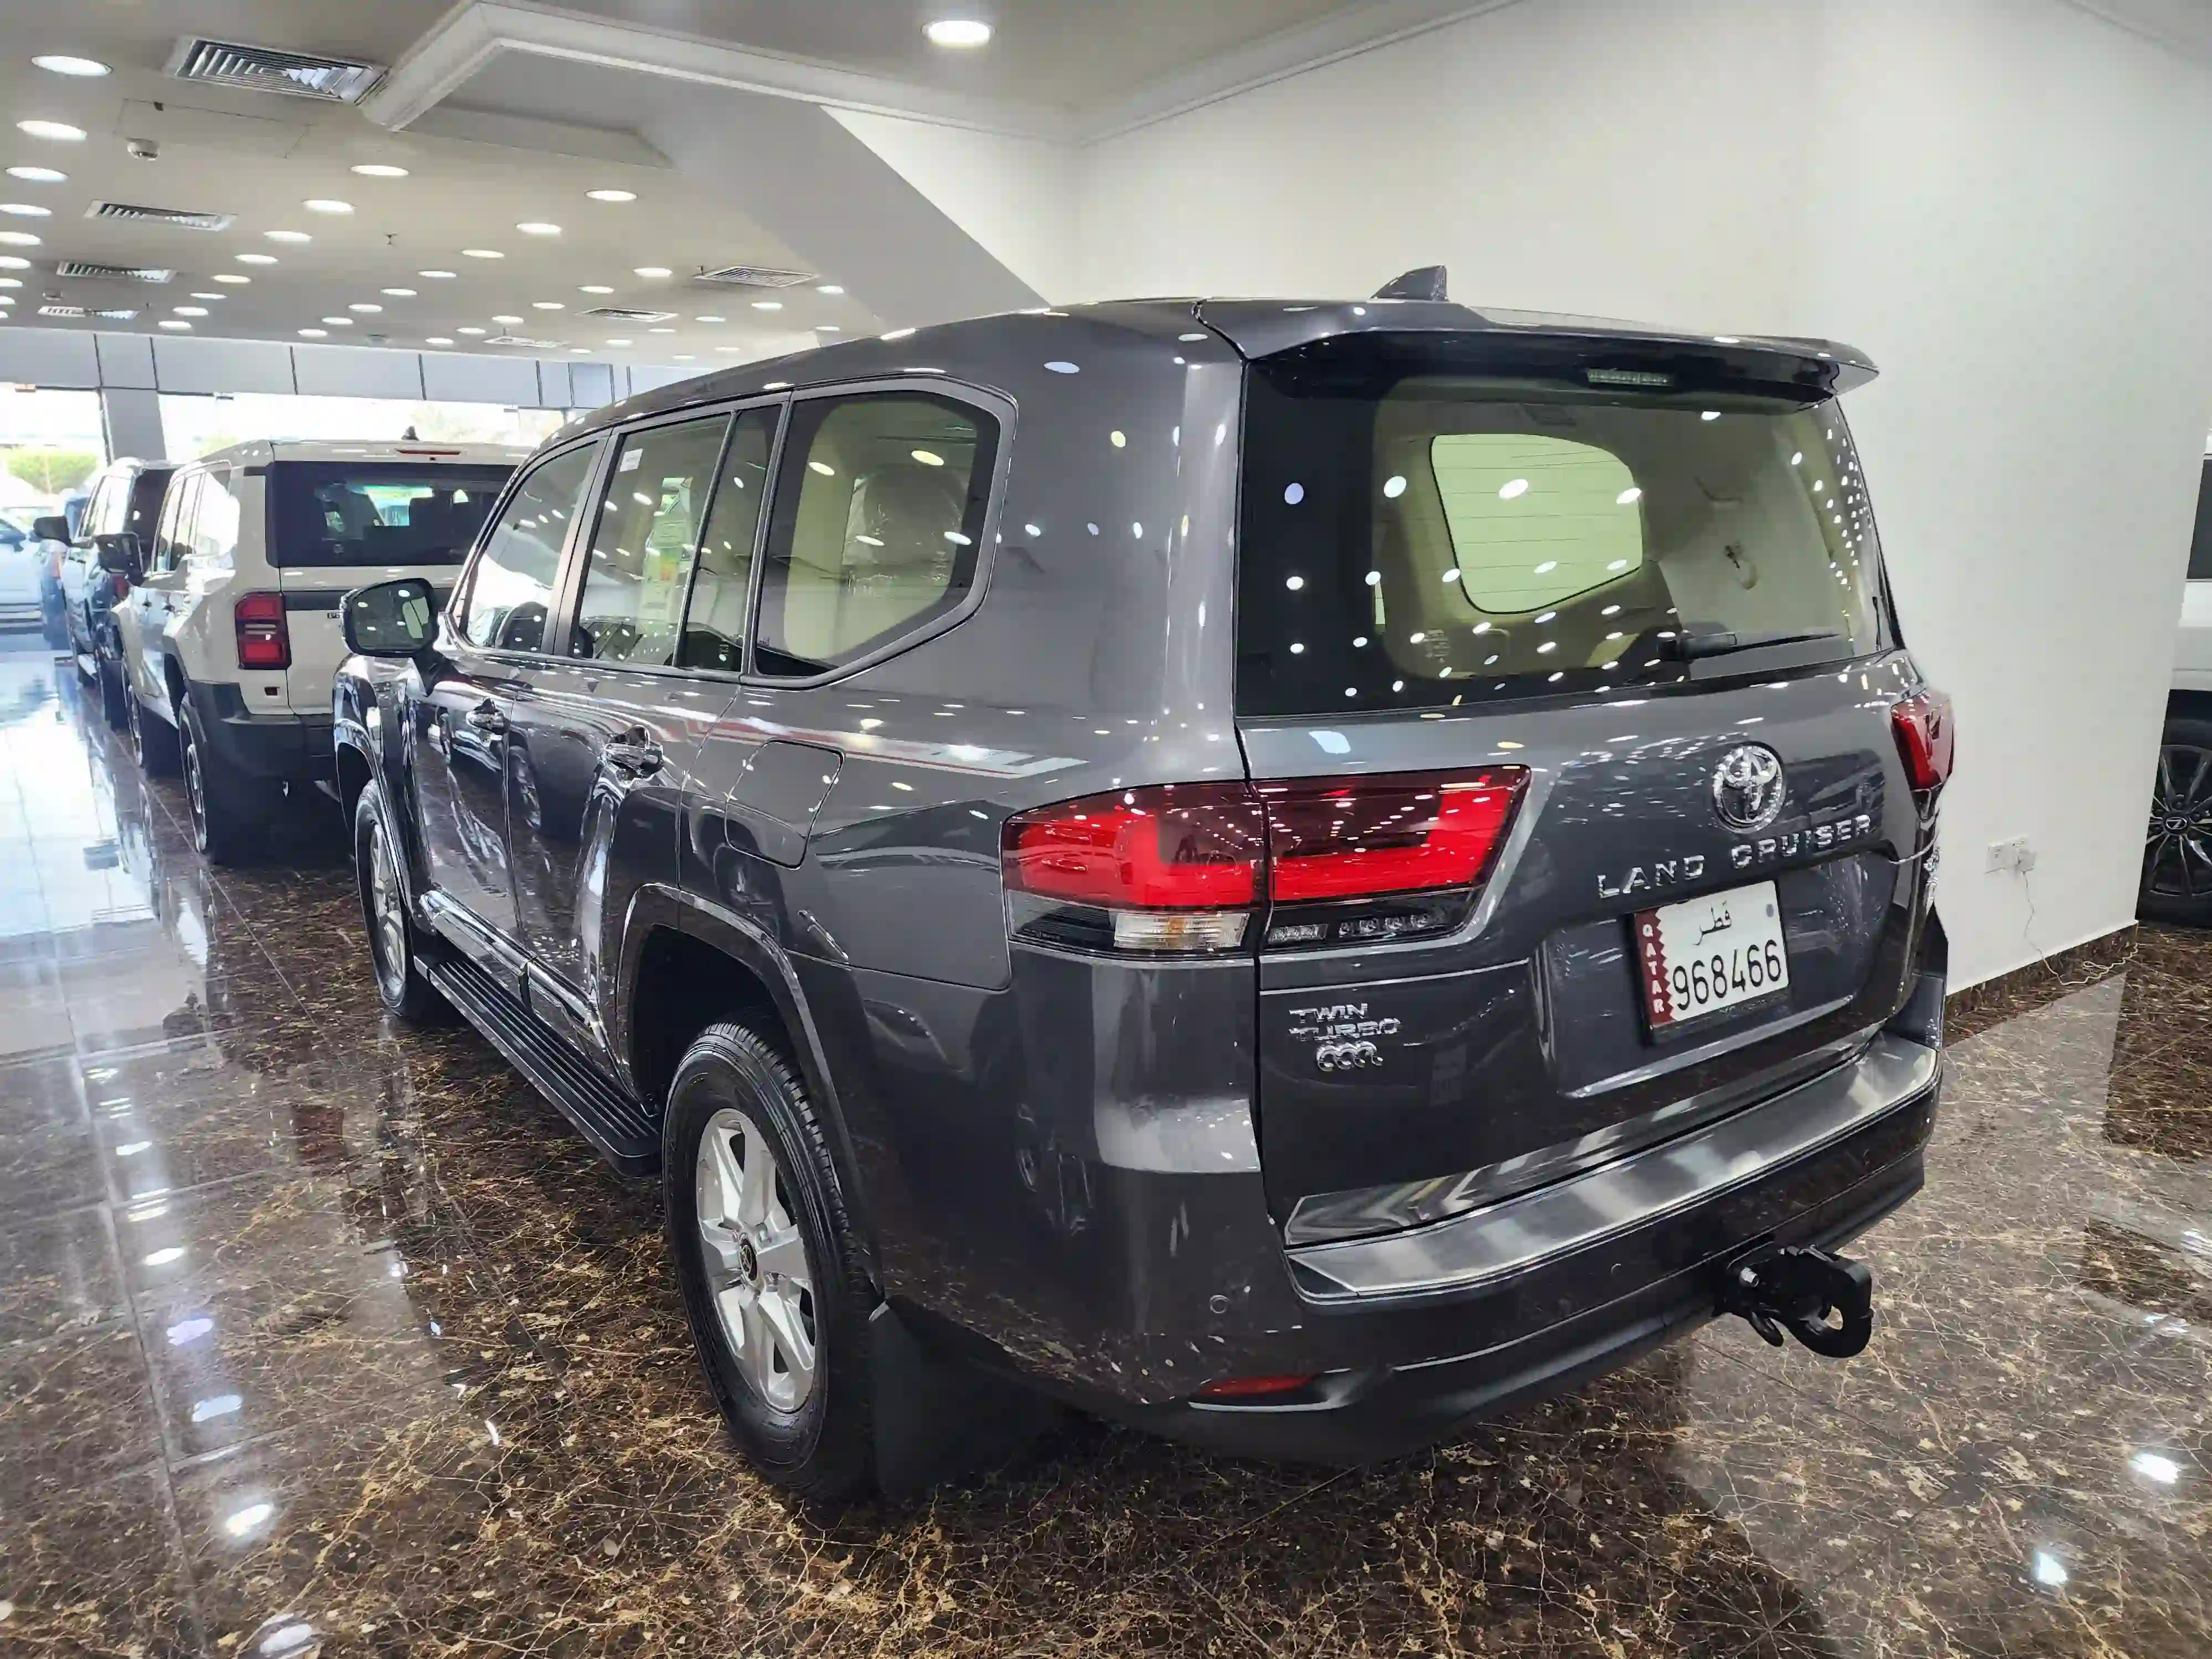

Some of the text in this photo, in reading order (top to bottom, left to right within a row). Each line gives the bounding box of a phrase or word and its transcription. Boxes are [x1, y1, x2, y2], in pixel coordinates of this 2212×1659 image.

[1597, 814, 1871, 899] LAND CRUISER
[1692, 900, 1732, 945] قطر
[1642, 923, 1665, 1014] QATAR
[1672, 939, 1781, 1010] 968466
[1289, 1002, 1368, 1024] TWIN
[1289, 1017, 1401, 1042] TURBO
